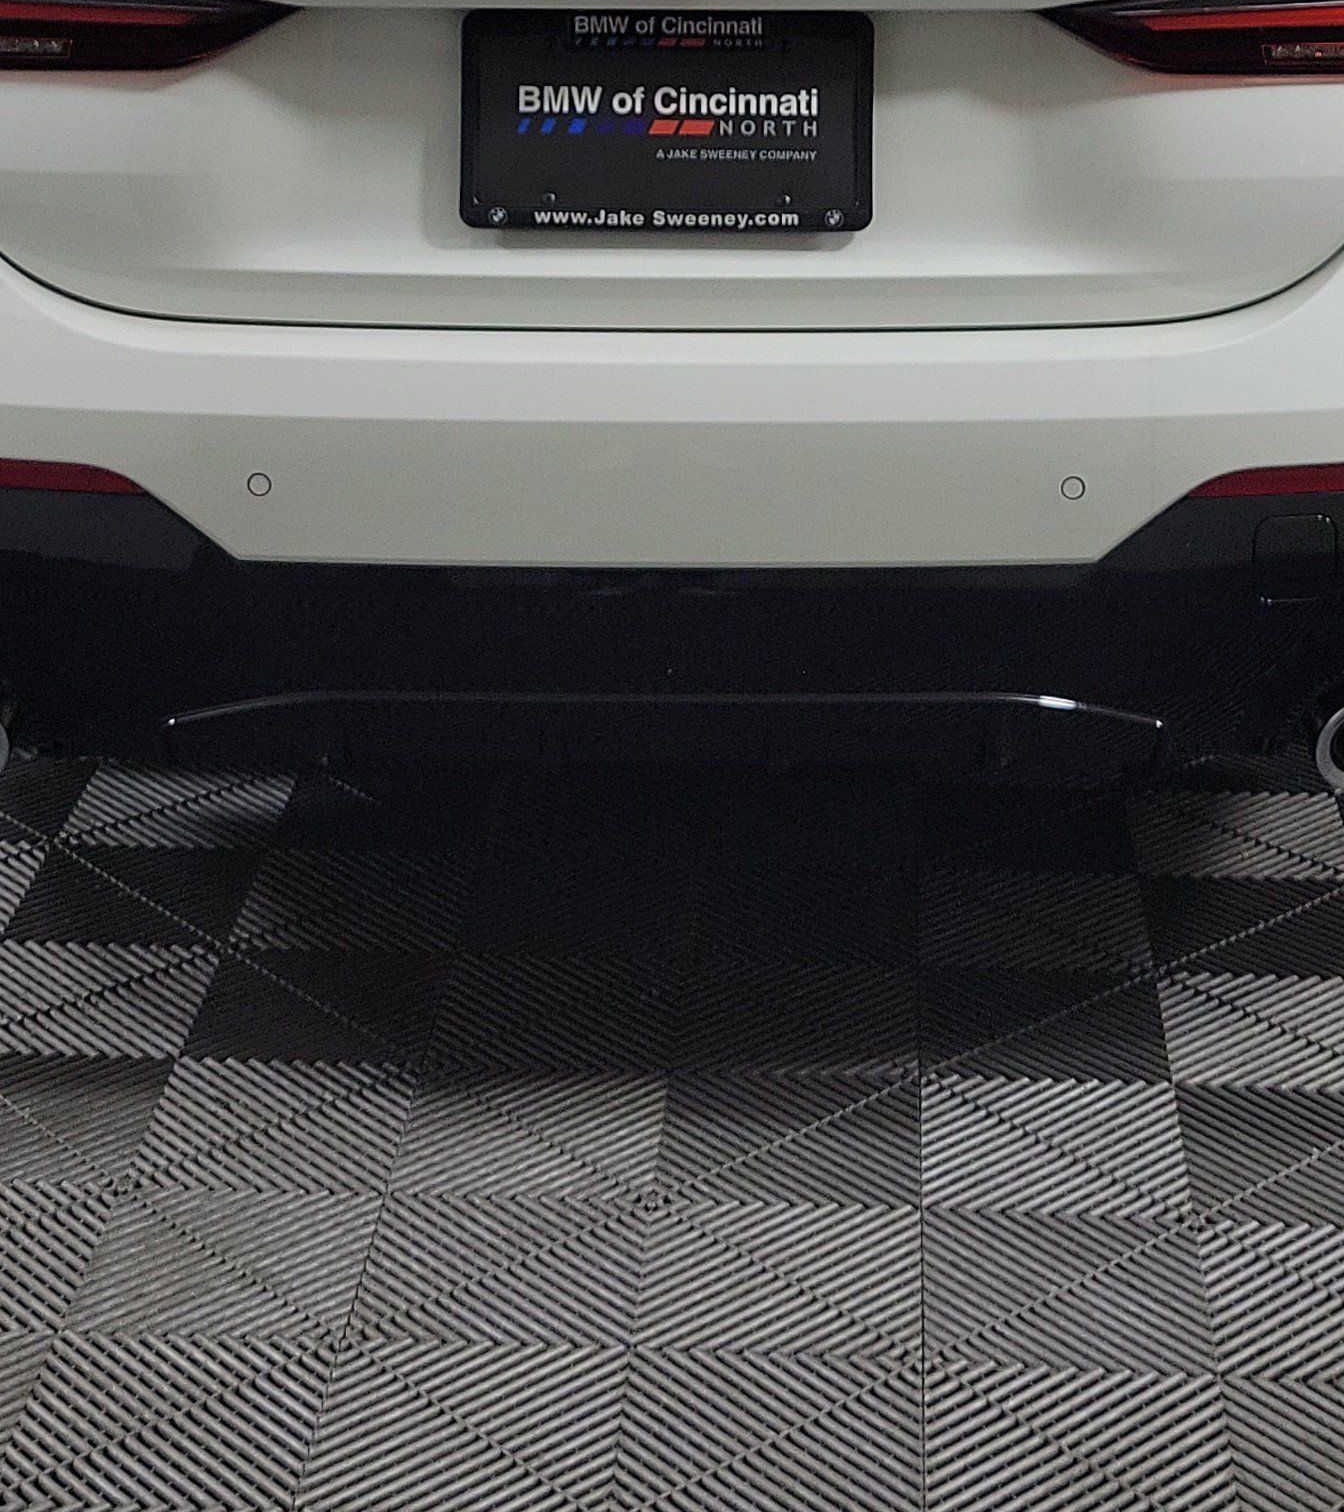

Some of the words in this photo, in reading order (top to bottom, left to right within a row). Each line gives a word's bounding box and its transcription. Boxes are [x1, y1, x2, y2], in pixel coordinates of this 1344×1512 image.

[574, 15, 629, 35] BMW
[635, 16, 655, 34] of
[661, 15, 763, 36] Cincinnati
[518, 85, 602, 114] BMW
[612, 86, 645, 115] of
[654, 86, 818, 117] Cincinnati
[719, 119, 818, 137] NORTH
[656, 148, 666, 159] A
[667, 148, 697, 160] JAKE
[700, 149, 756, 161] SWEENEY
[759, 149, 818, 162] COMPANY
[534, 209, 645, 226] www.Jake
[653, 210, 800, 229] Sweeney.com
